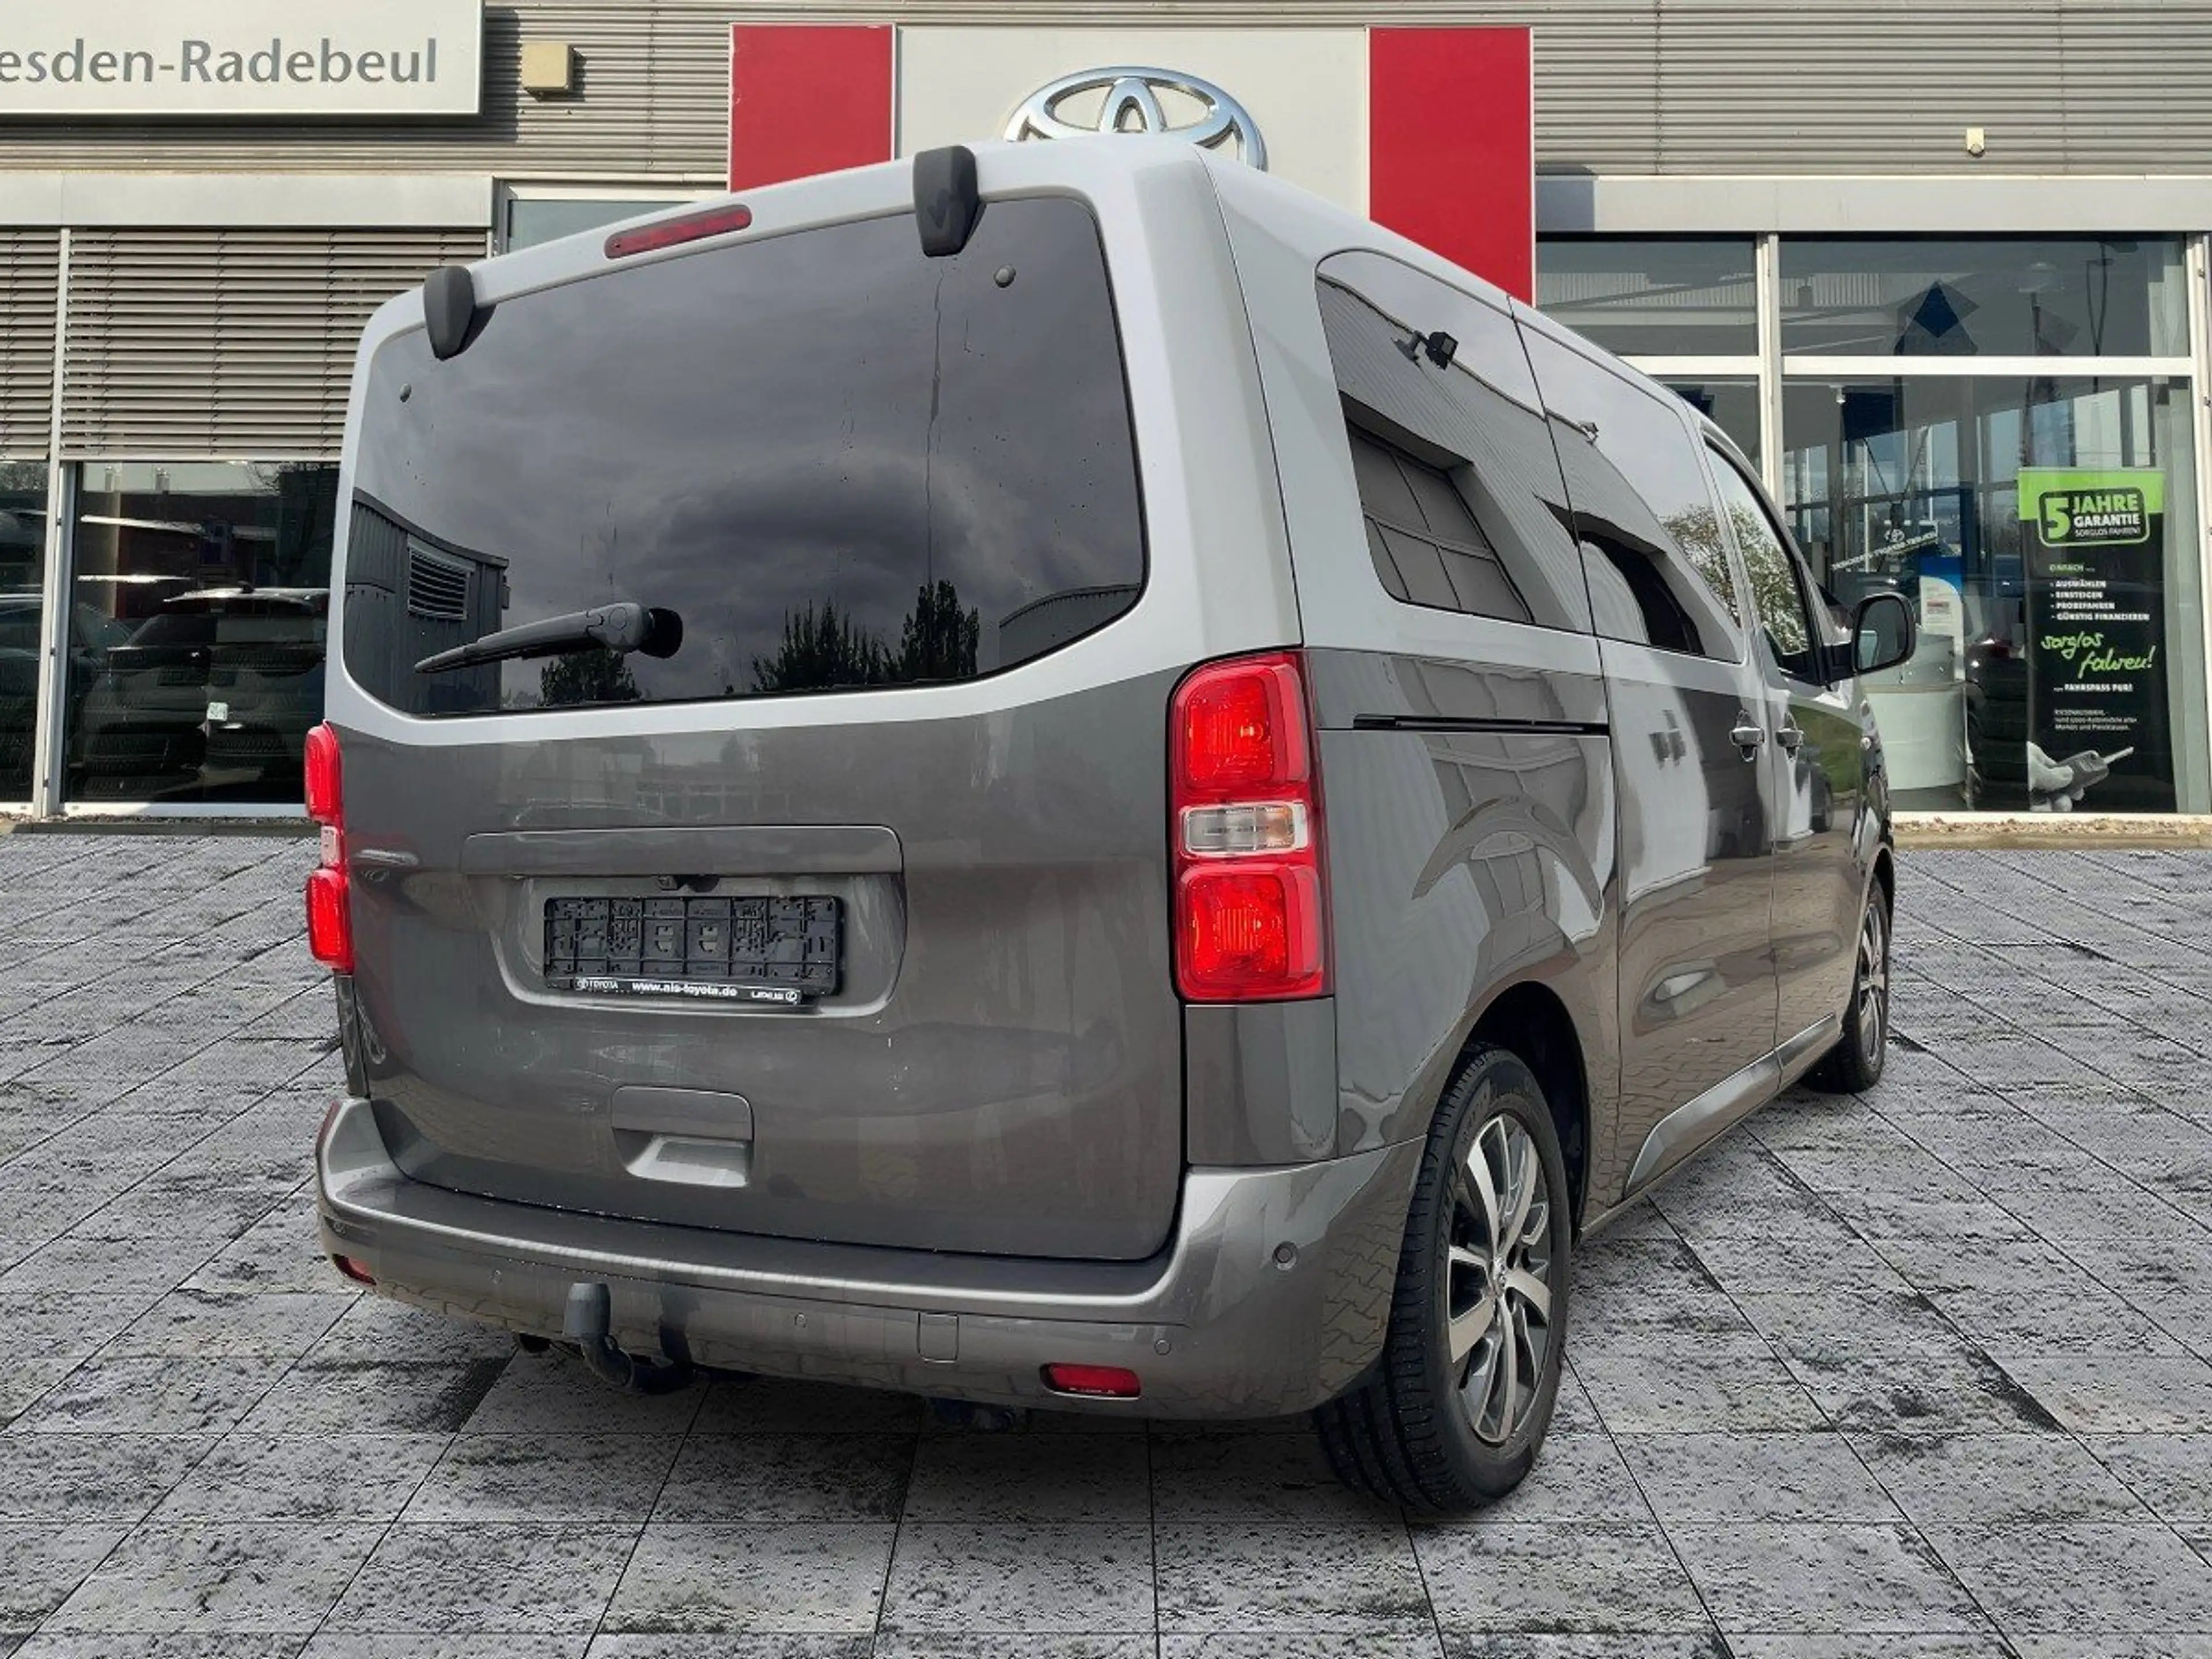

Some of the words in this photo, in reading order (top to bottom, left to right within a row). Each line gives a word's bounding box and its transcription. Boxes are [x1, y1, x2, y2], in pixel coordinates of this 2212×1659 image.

[2045, 497, 2071, 539] 5
[2072, 494, 2139, 514] JAHRE
[2073, 513, 2141, 528] GARANTIE
[2075, 528, 2108, 537] SORGLOS
[2055, 579, 2107, 589] AUSWÄHLEN
[2055, 591, 2104, 600] EINSTEIGEN
[2055, 602, 2116, 610] PROBEFAHREN
[2056, 612, 2093, 621] GÜNSTIG
[2094, 613, 2150, 622] FINANZIEREN
[2040, 630, 2104, 660] sorglos
[589, 980, 619, 990] TOYOTA
